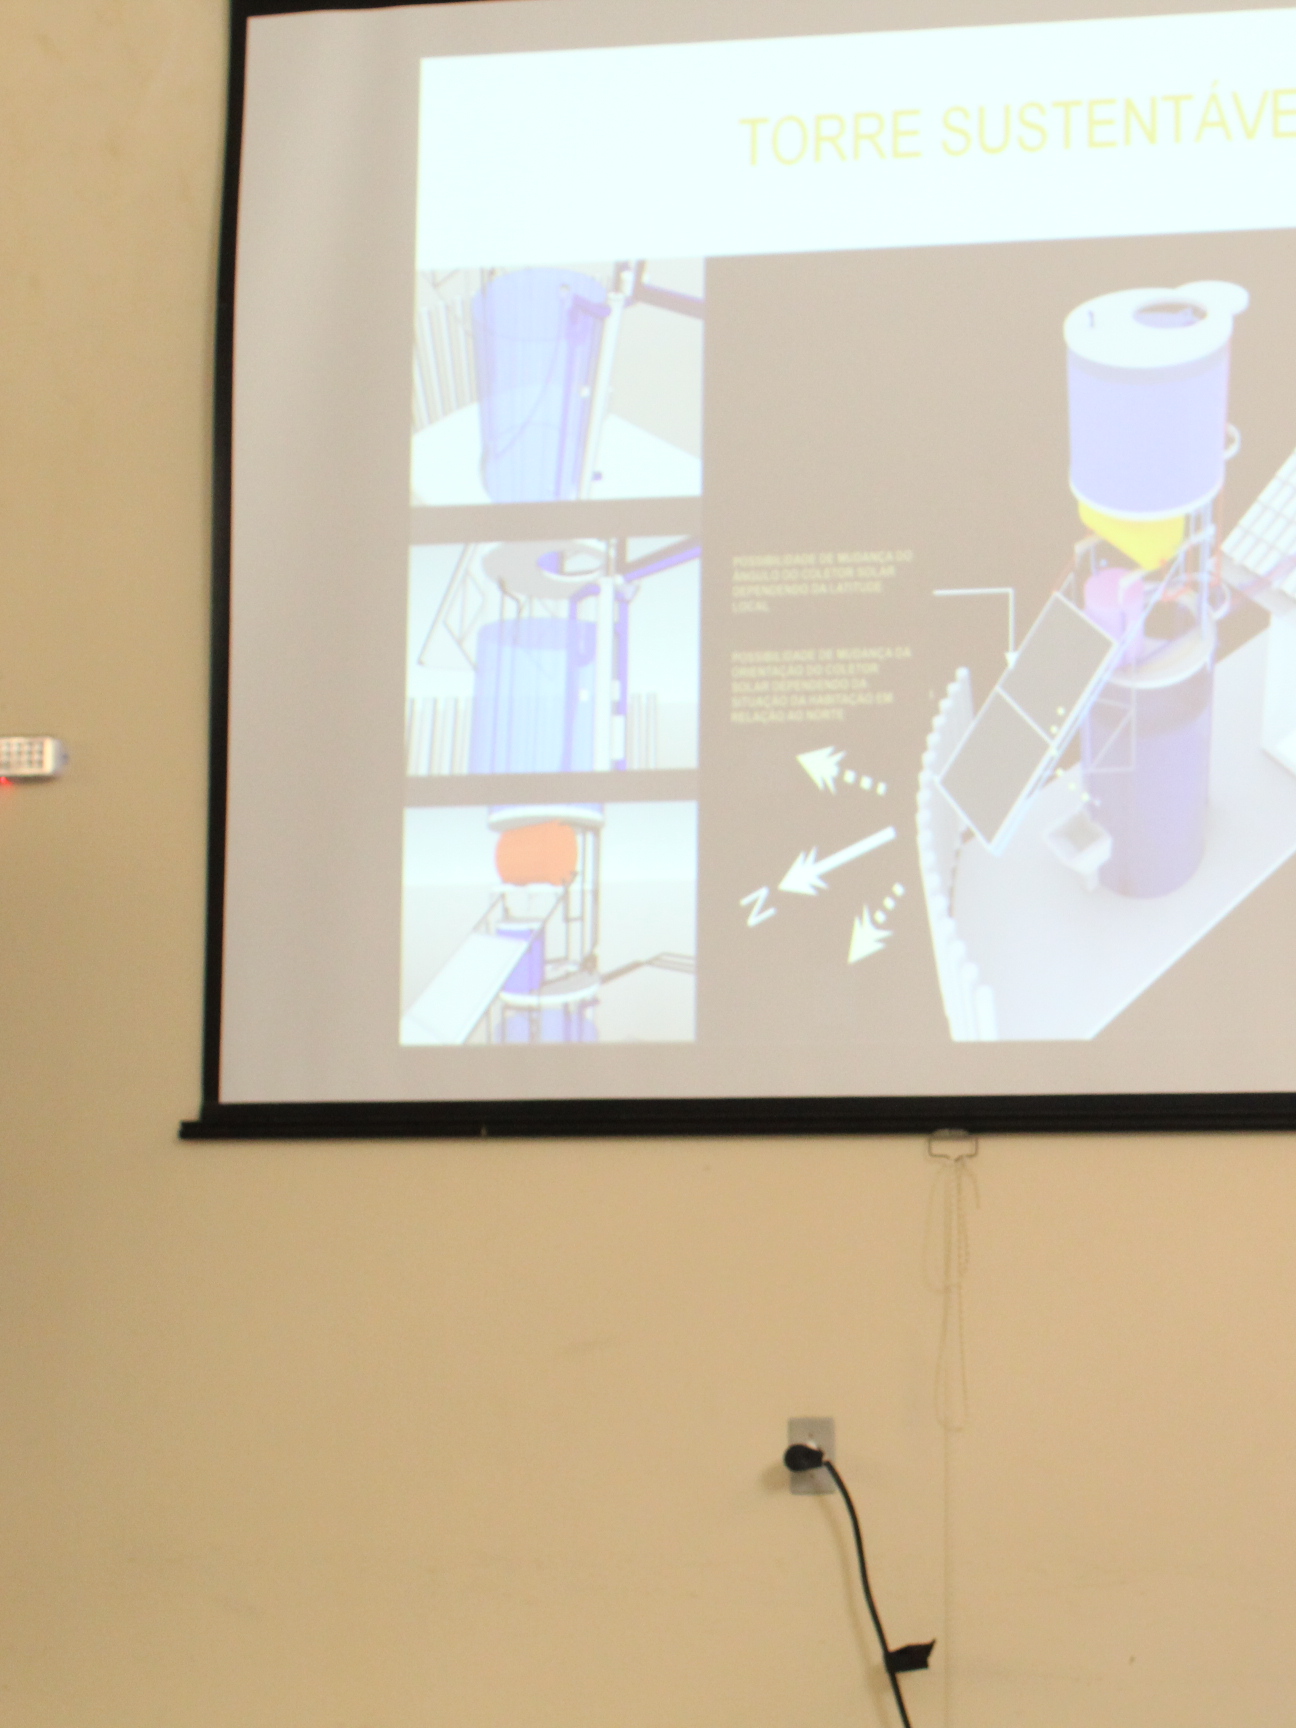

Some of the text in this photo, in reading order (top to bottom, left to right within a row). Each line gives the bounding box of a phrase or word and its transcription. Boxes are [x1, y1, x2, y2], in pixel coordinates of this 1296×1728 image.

[740, 107, 922, 166] TORRE
[896, 549, 913, 562] DO
[739, 886, 777, 927] N
